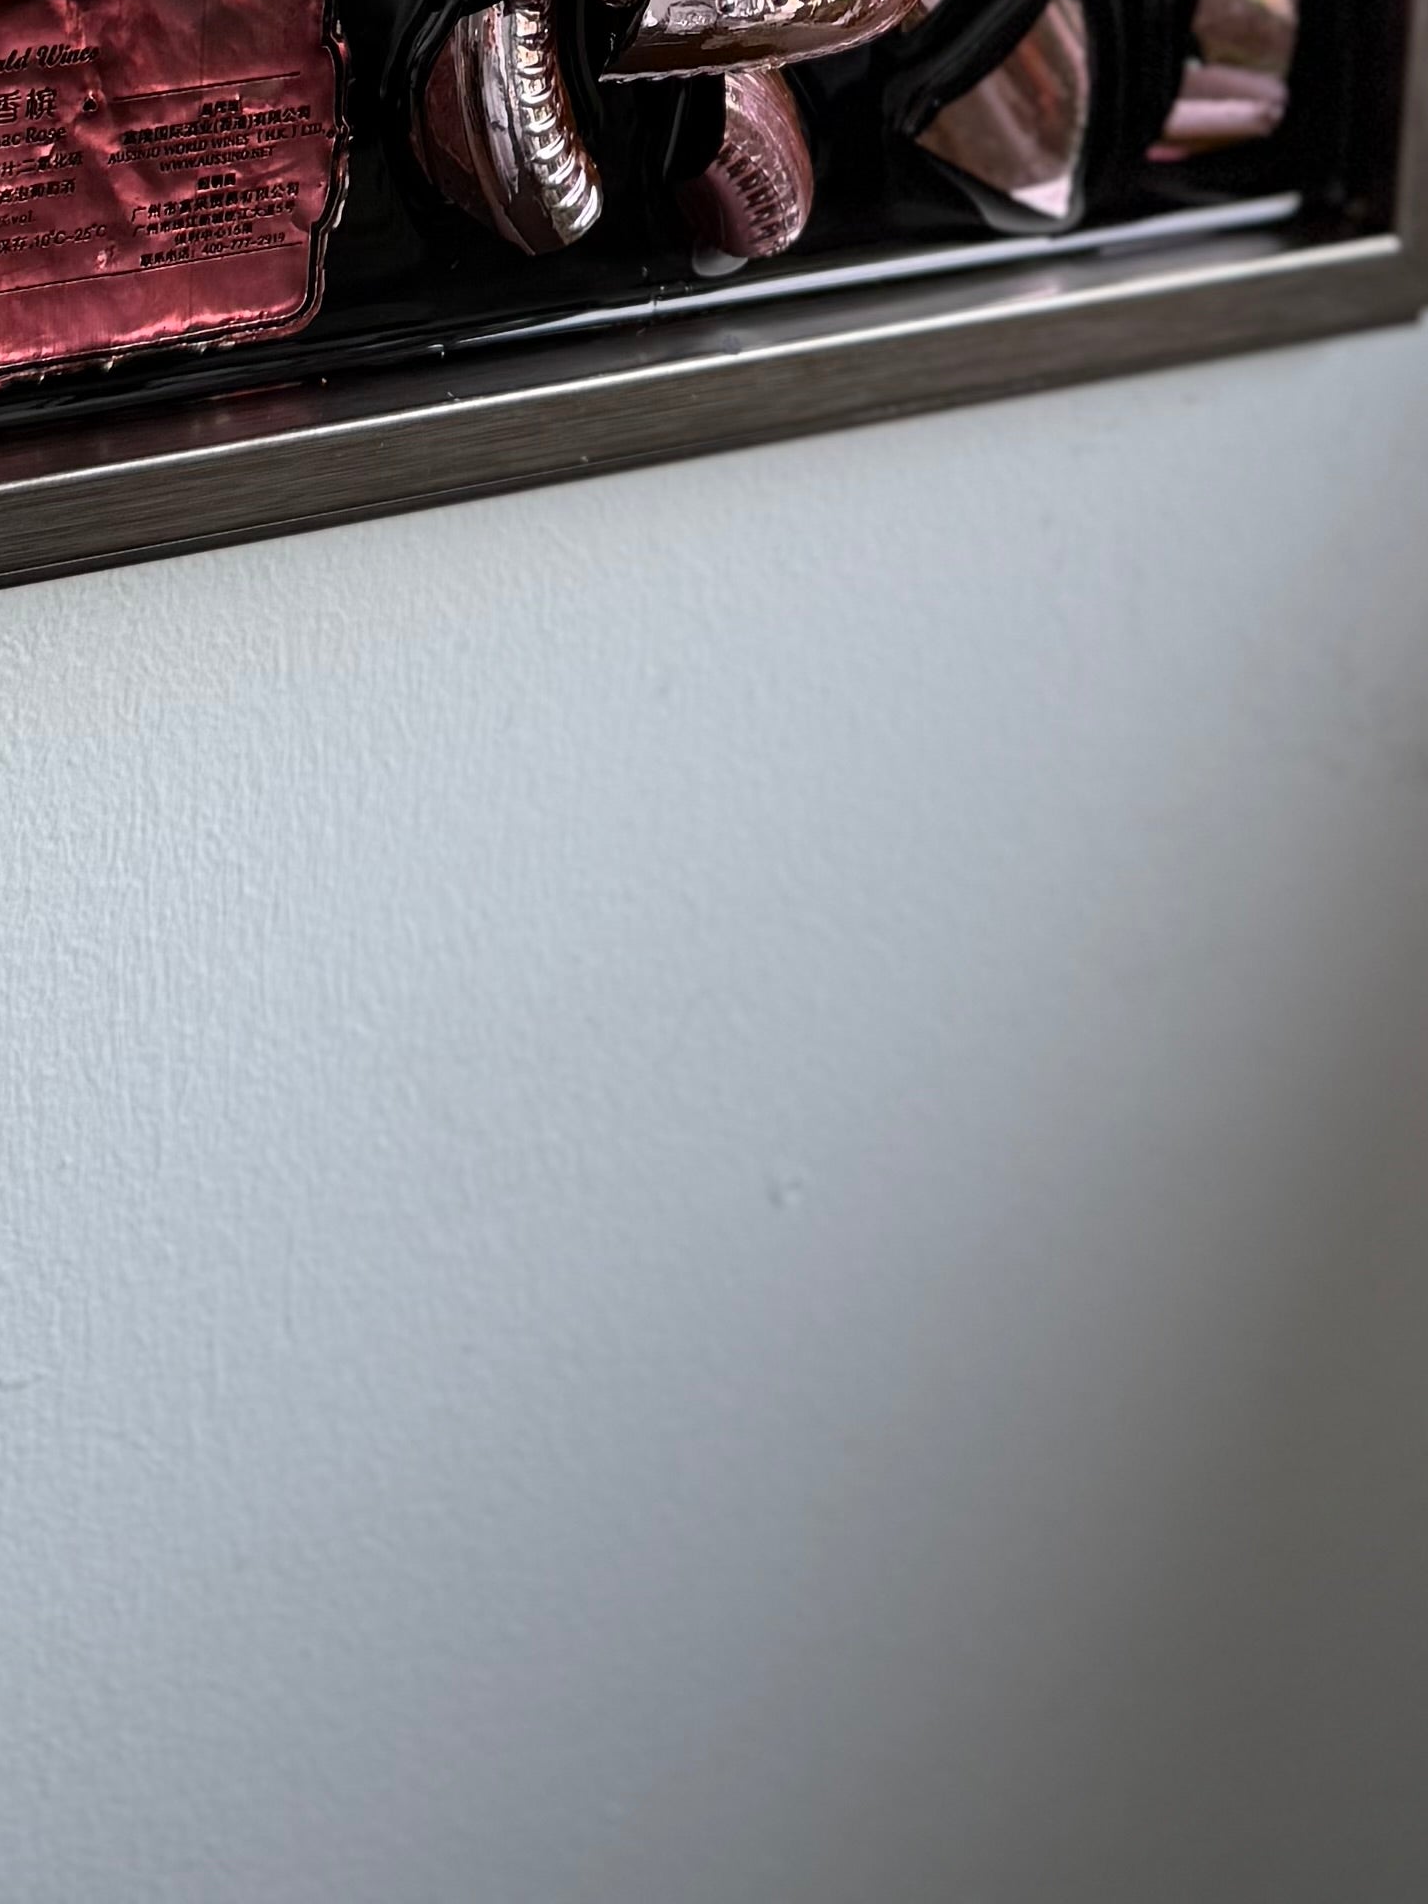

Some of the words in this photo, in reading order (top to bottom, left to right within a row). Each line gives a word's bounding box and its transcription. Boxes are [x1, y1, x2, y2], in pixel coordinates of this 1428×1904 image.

[36, 44, 99, 68] Wines
[164, 140, 207, 157] WORLD
[211, 135, 249, 150] WINES
